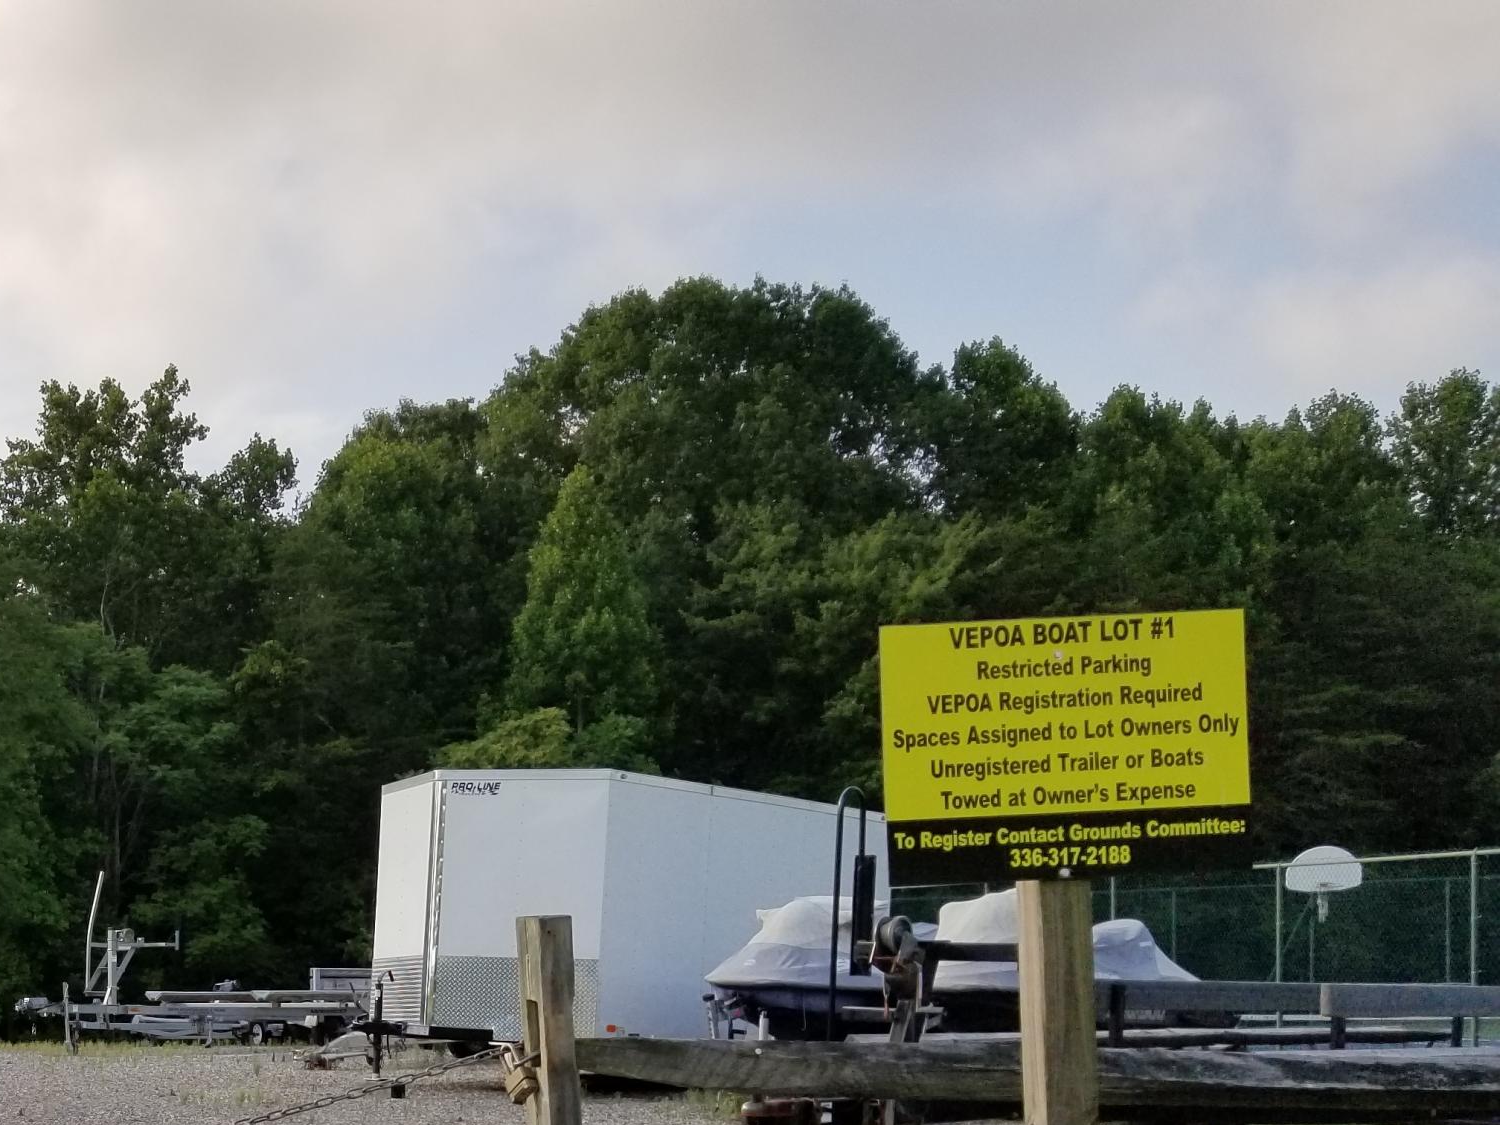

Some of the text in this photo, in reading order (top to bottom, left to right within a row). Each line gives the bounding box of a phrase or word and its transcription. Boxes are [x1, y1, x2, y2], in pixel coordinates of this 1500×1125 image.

[949, 616, 1174, 650] VEPOA BOAT LOT #1
[977, 653, 1151, 680] Restricted Parking
[927, 682, 1203, 715] VEPOA Registration Required
[893, 713, 1240, 753] Spaces Assigned to Lot Owners Only
[930, 747, 1204, 781] Unregistered Trailer or Boats
[940, 782, 1196, 810] Towed at Owner's Expense
[893, 817, 1246, 852] To Register Contact Grounds Committee:
[1009, 845, 1132, 868] 336-317-2188
